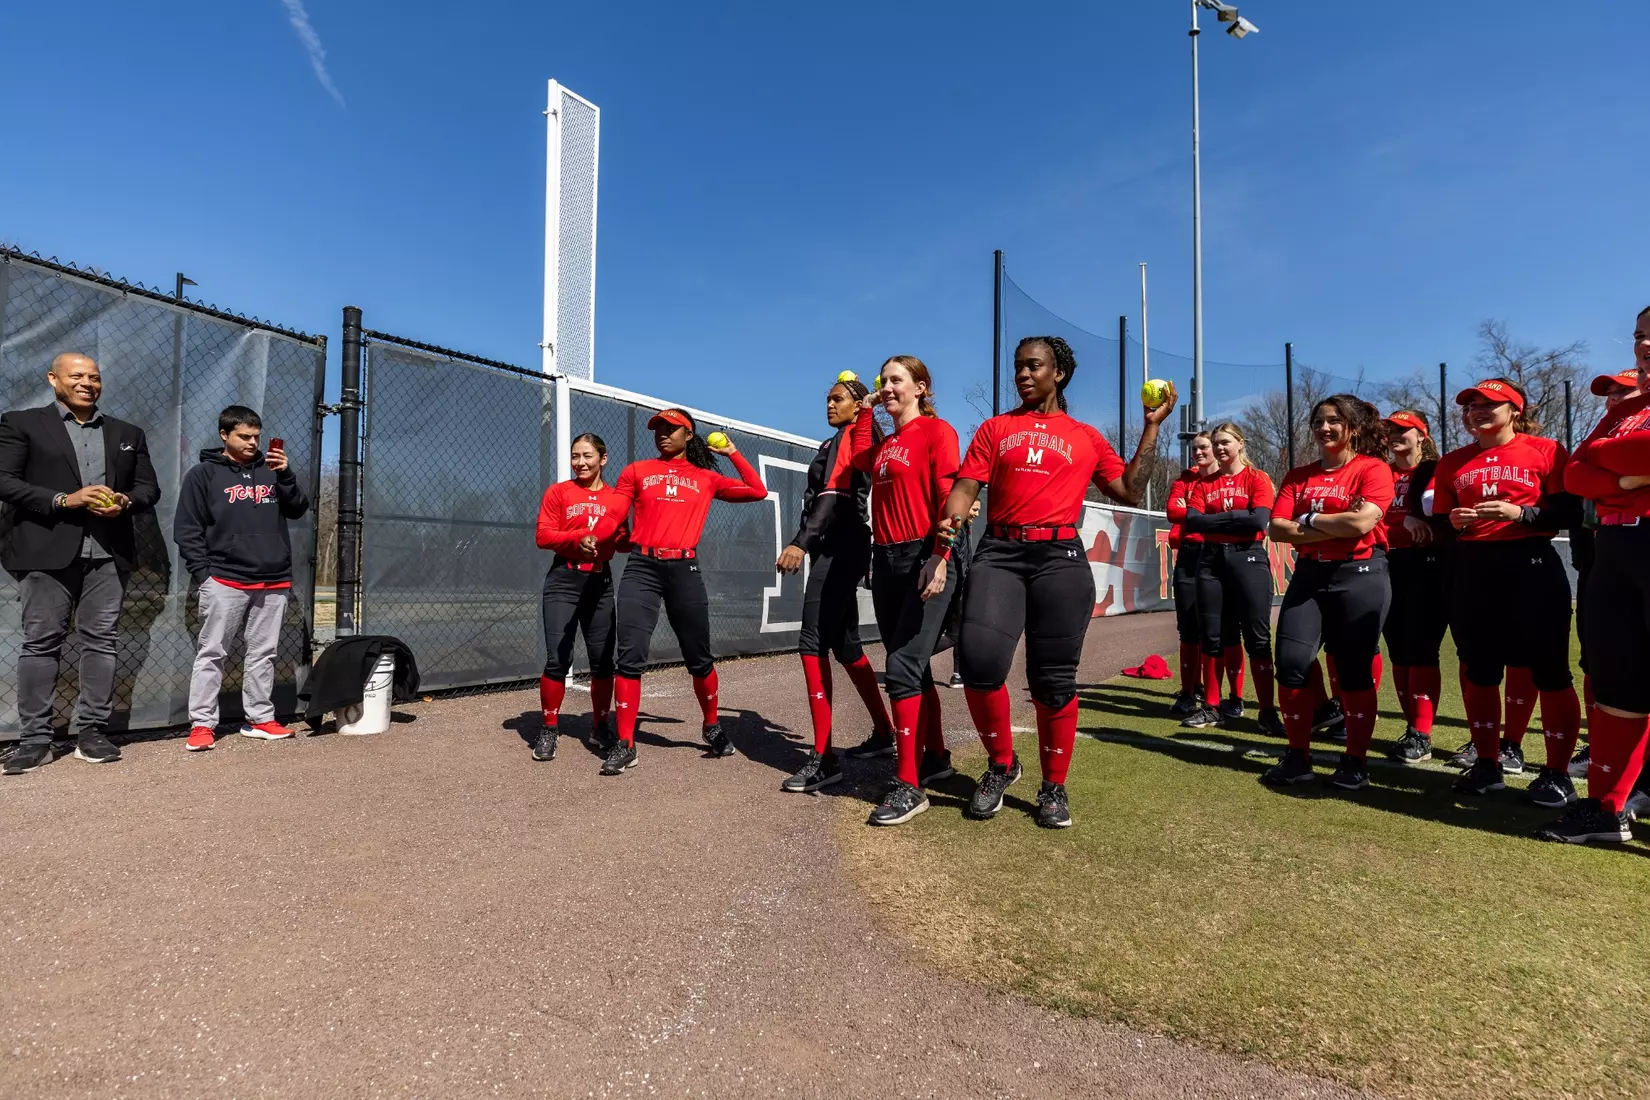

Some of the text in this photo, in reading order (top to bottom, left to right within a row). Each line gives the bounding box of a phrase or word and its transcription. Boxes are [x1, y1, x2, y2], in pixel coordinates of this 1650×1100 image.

[999, 430, 1074, 465] SOFTBALL
[1026, 447, 1044, 465] M
[642, 473, 700, 494] SOFTBALL
[1453, 465, 1535, 494] SOFTBALL
[224, 484, 276, 504] Terps
[665, 484, 678, 497] M
[1482, 482, 1499, 498] M
[1223, 497, 1234, 509] M
[1310, 498, 1325, 512] M
[1392, 494, 1405, 507] M
[566, 502, 607, 520] SOFTBA
